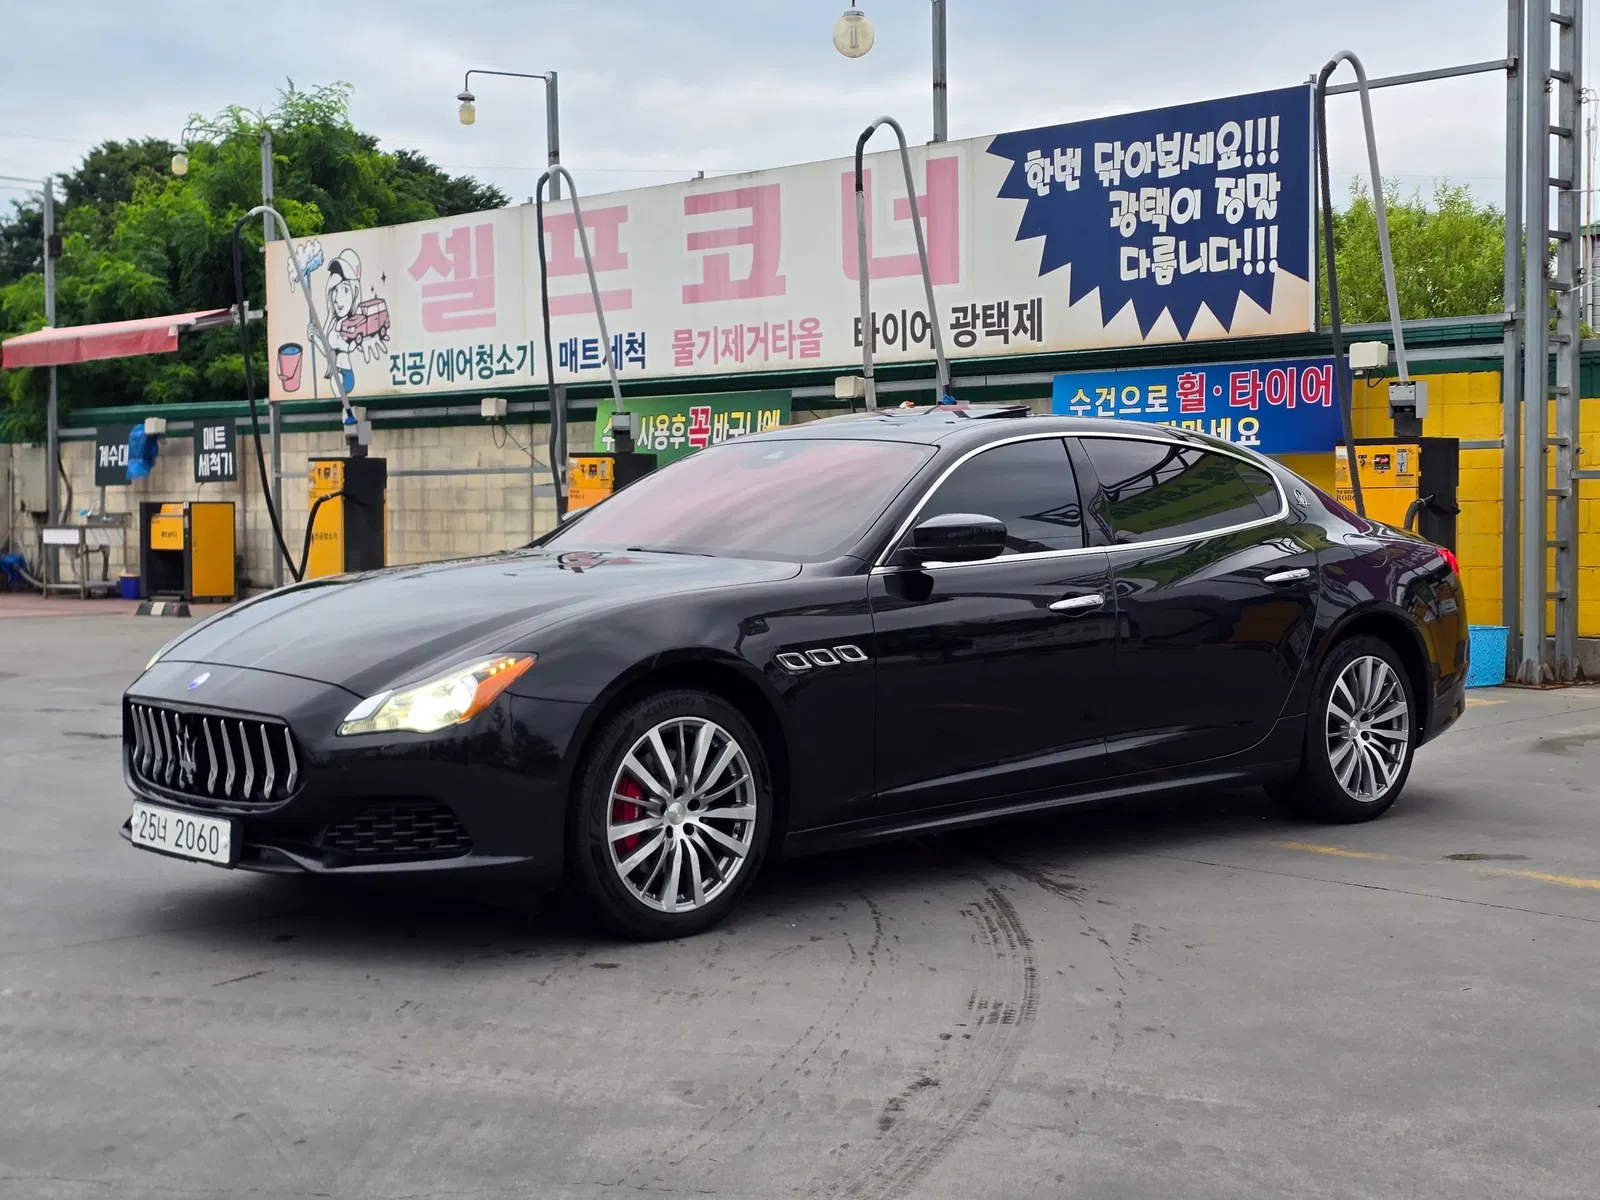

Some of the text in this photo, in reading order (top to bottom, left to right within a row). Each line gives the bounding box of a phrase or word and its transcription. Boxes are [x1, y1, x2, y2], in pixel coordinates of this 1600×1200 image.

[1024, 115, 1280, 197] 한번 닦아보세요!!!
[1109, 172, 1281, 238] 광택이 정말
[389, 297, 1043, 386] 진공/에어청소기 매트세척 물기제거타올 타이어 광택제
[1069, 384, 1169, 416] 수건으로
[203, 426, 226, 450] 매트
[637, 413, 686, 451] 사용후
[688, 406, 711, 449] 꼭
[198, 452, 233, 477] 세척기
[139, 810, 220, 855] 25너 2060
